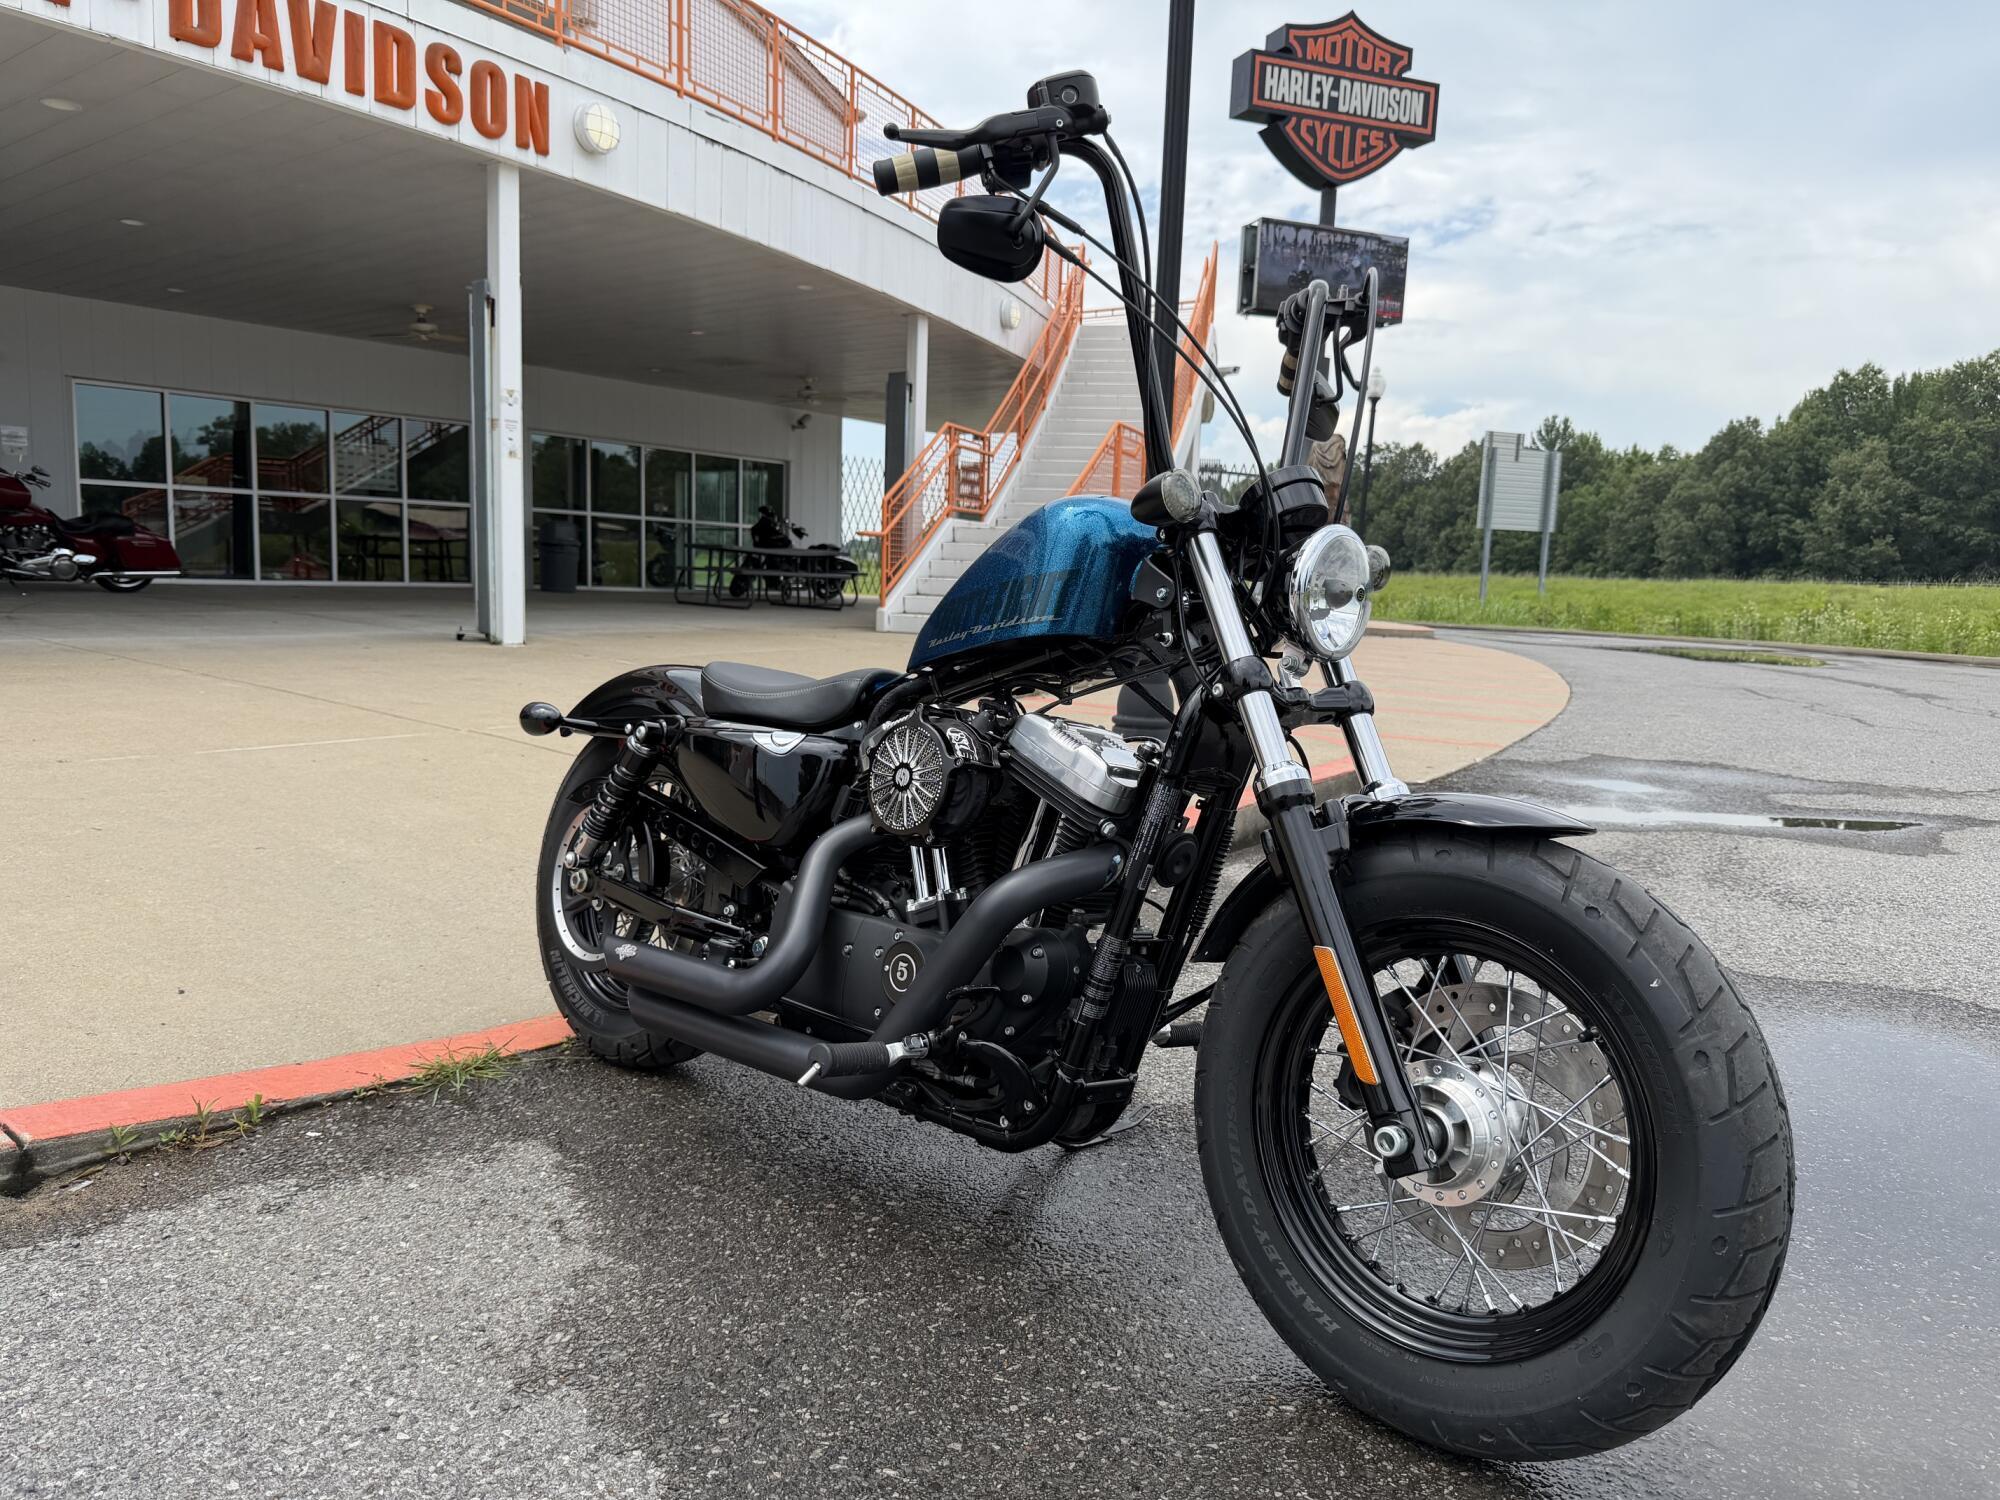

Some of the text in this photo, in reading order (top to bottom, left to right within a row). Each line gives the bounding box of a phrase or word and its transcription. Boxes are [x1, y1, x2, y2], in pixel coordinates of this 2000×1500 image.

[1306, 28, 1391, 76] MOTOR
[1264, 64, 1425, 126] HARLEY-DAVIDSON
[1301, 119, 1384, 170] CYCLES
[928, 615, 1062, 649] Harley-Davidson
[549, 949, 594, 1017] MICHELIN
[896, 960, 909, 981] 5
